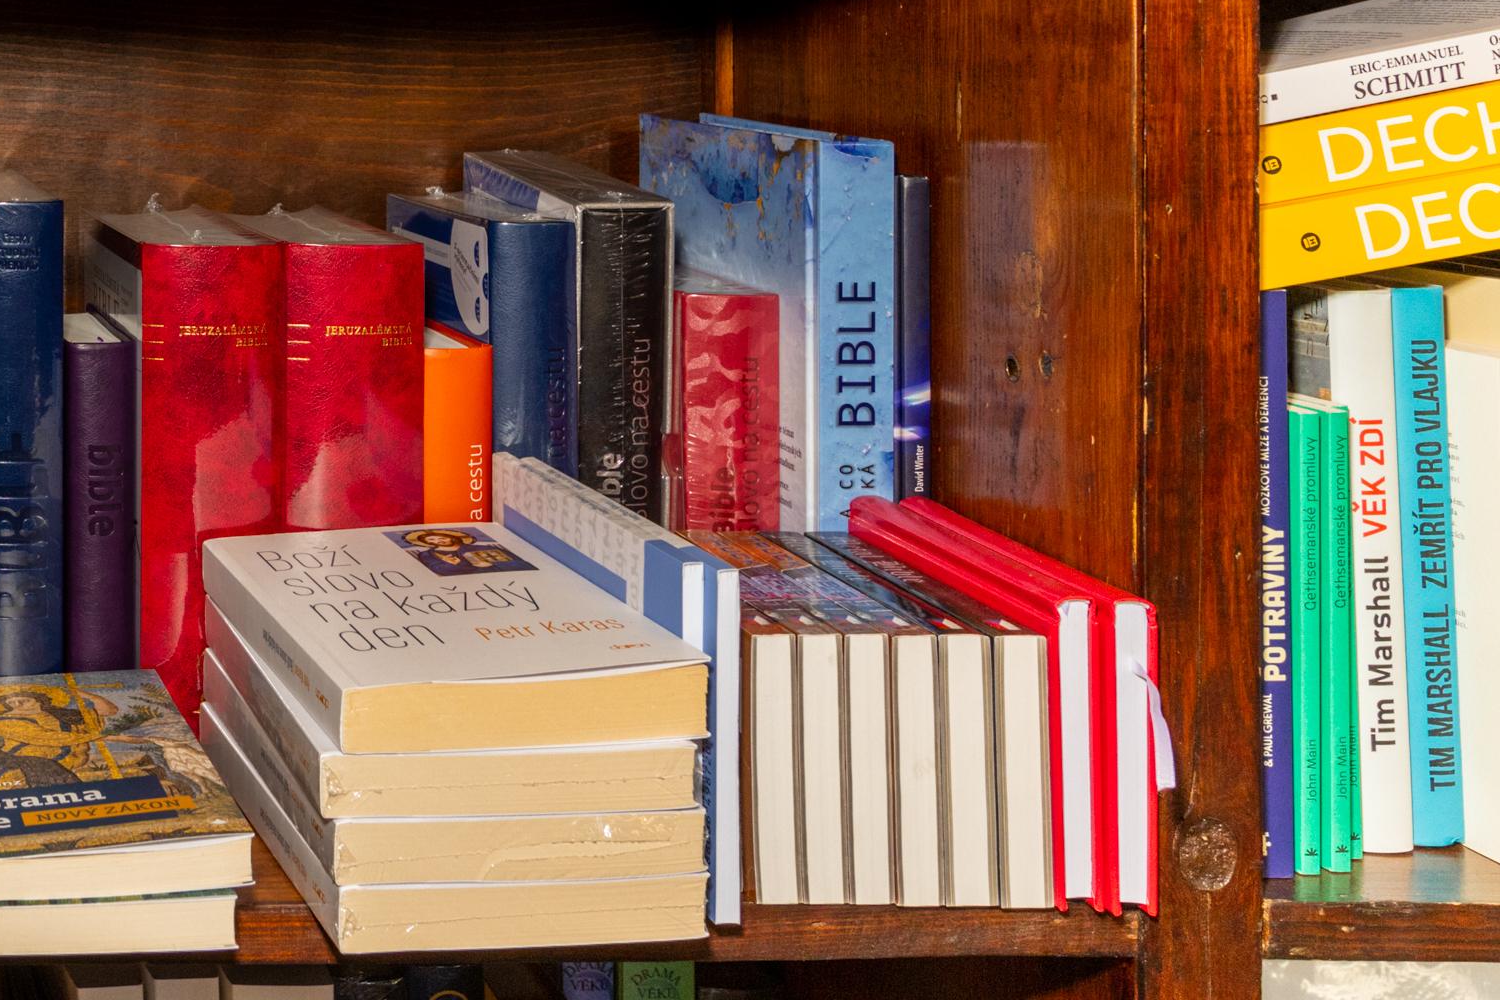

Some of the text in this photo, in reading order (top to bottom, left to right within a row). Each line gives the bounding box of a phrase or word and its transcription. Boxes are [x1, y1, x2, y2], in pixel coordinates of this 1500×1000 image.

[1350, 45, 1464, 76] ERIC-EMMANUEL
[1353, 61, 1466, 100] SCHMITT
[178, 321, 268, 337] JERUZALÉMSKÁ
[630, 337, 651, 409] cestu
[838, 281, 876, 427] BIBLE
[1259, 376, 1269, 423] DEMENCI
[631, 415, 650, 446] na
[914, 445, 924, 493] David Winter
[87, 443, 123, 538] bible
[256, 543, 362, 573] Boží
[1411, 338, 1456, 792] TIM MARSHALL ZEMŘÍT PRO VLAJKU
[283, 568, 415, 599] slovo
[309, 580, 541, 622] na každý
[1349, 417, 1396, 752] Tim Marshall VĚK ZDÍ
[1263, 525, 1287, 683] POTRAVINY
[1304, 437, 1319, 802] John Main Gethsemanské promluvy
[1333, 434, 1348, 799] John Main Gethsemanské promluvy
[339, 622, 446, 652] den
[474, 615, 626, 642] Petr Karas
[1262, 693, 1273, 733] GREWAL
[1263, 734, 1273, 757] PAUL
[36, 798, 181, 823] NOVÝ ZÁKON
[630, 967, 682, 986] DRAMA
